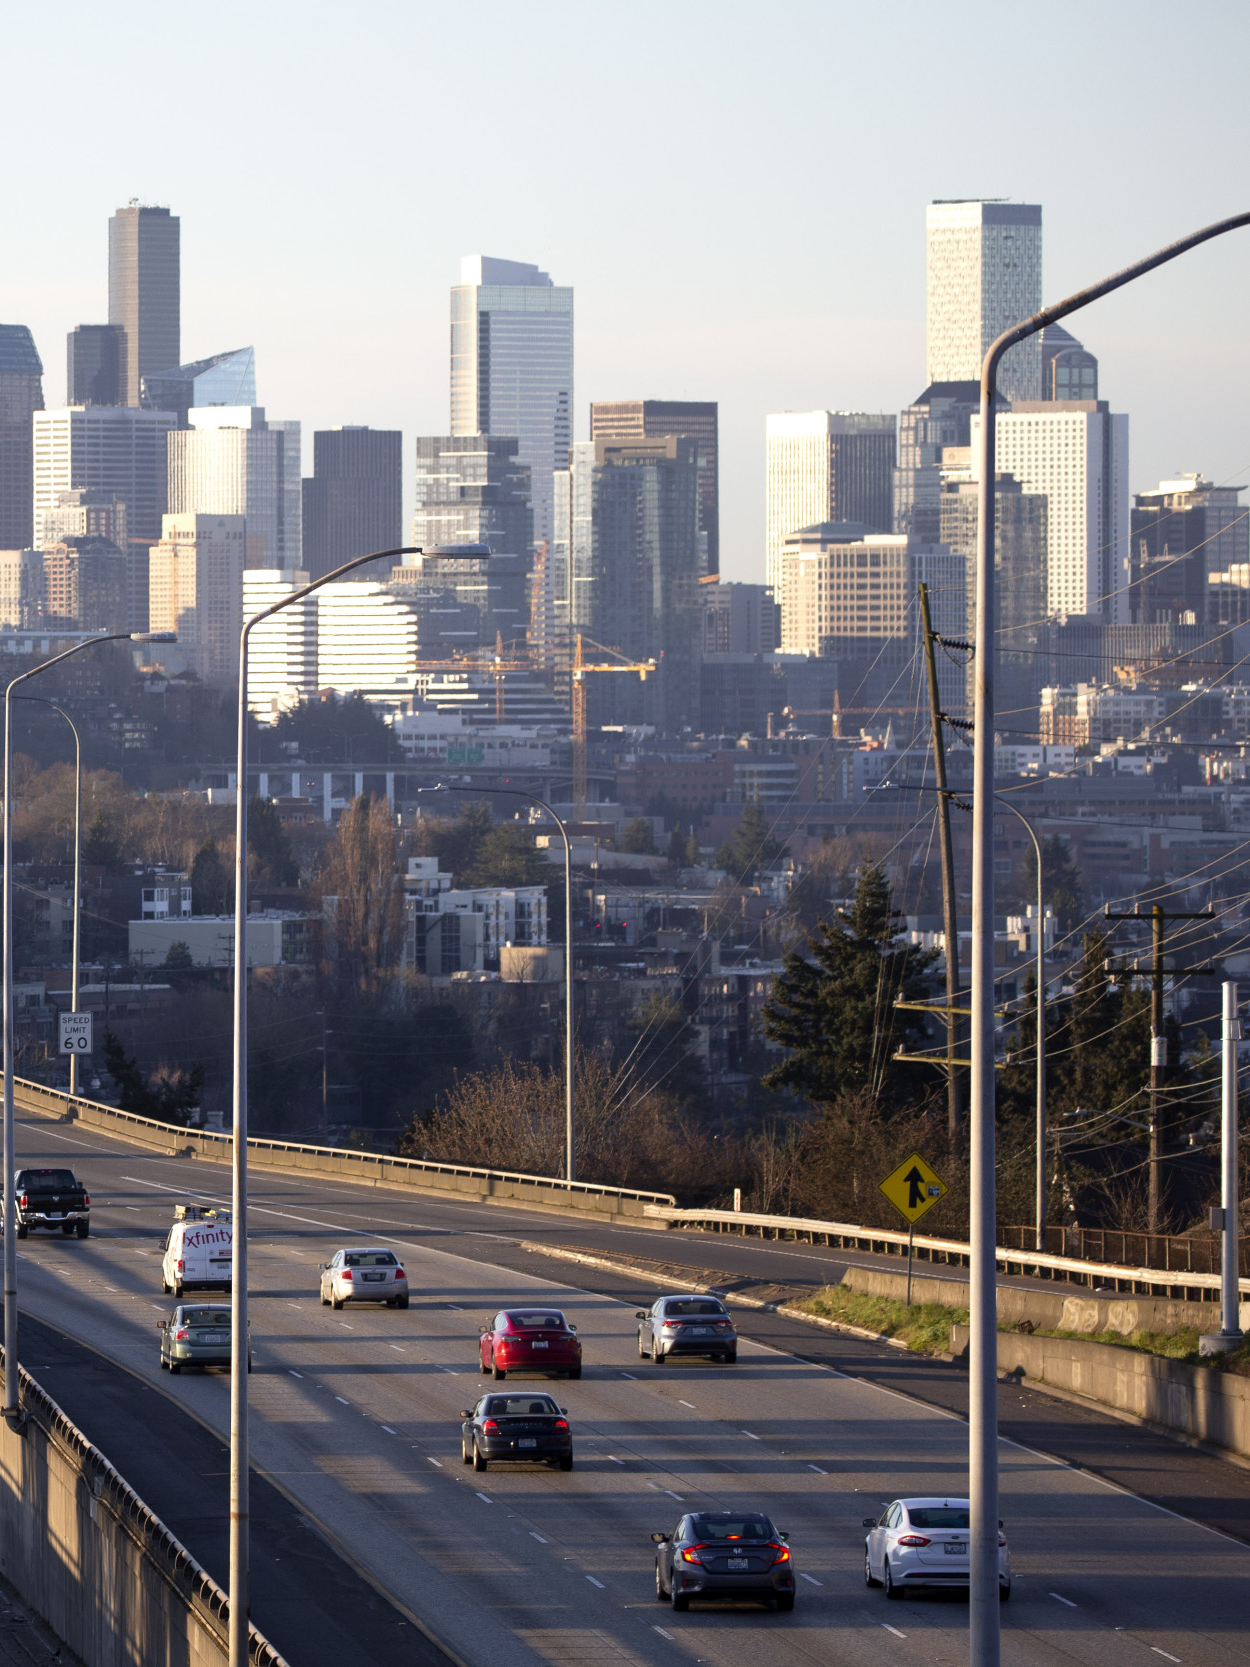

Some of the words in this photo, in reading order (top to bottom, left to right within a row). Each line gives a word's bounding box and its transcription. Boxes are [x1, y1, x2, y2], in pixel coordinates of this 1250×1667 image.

[62, 1016, 90, 1024] SPEED
[64, 1026, 86, 1034] LIMIT
[64, 1036, 88, 1049] 60
[186, 1229, 233, 1249] xfinity
